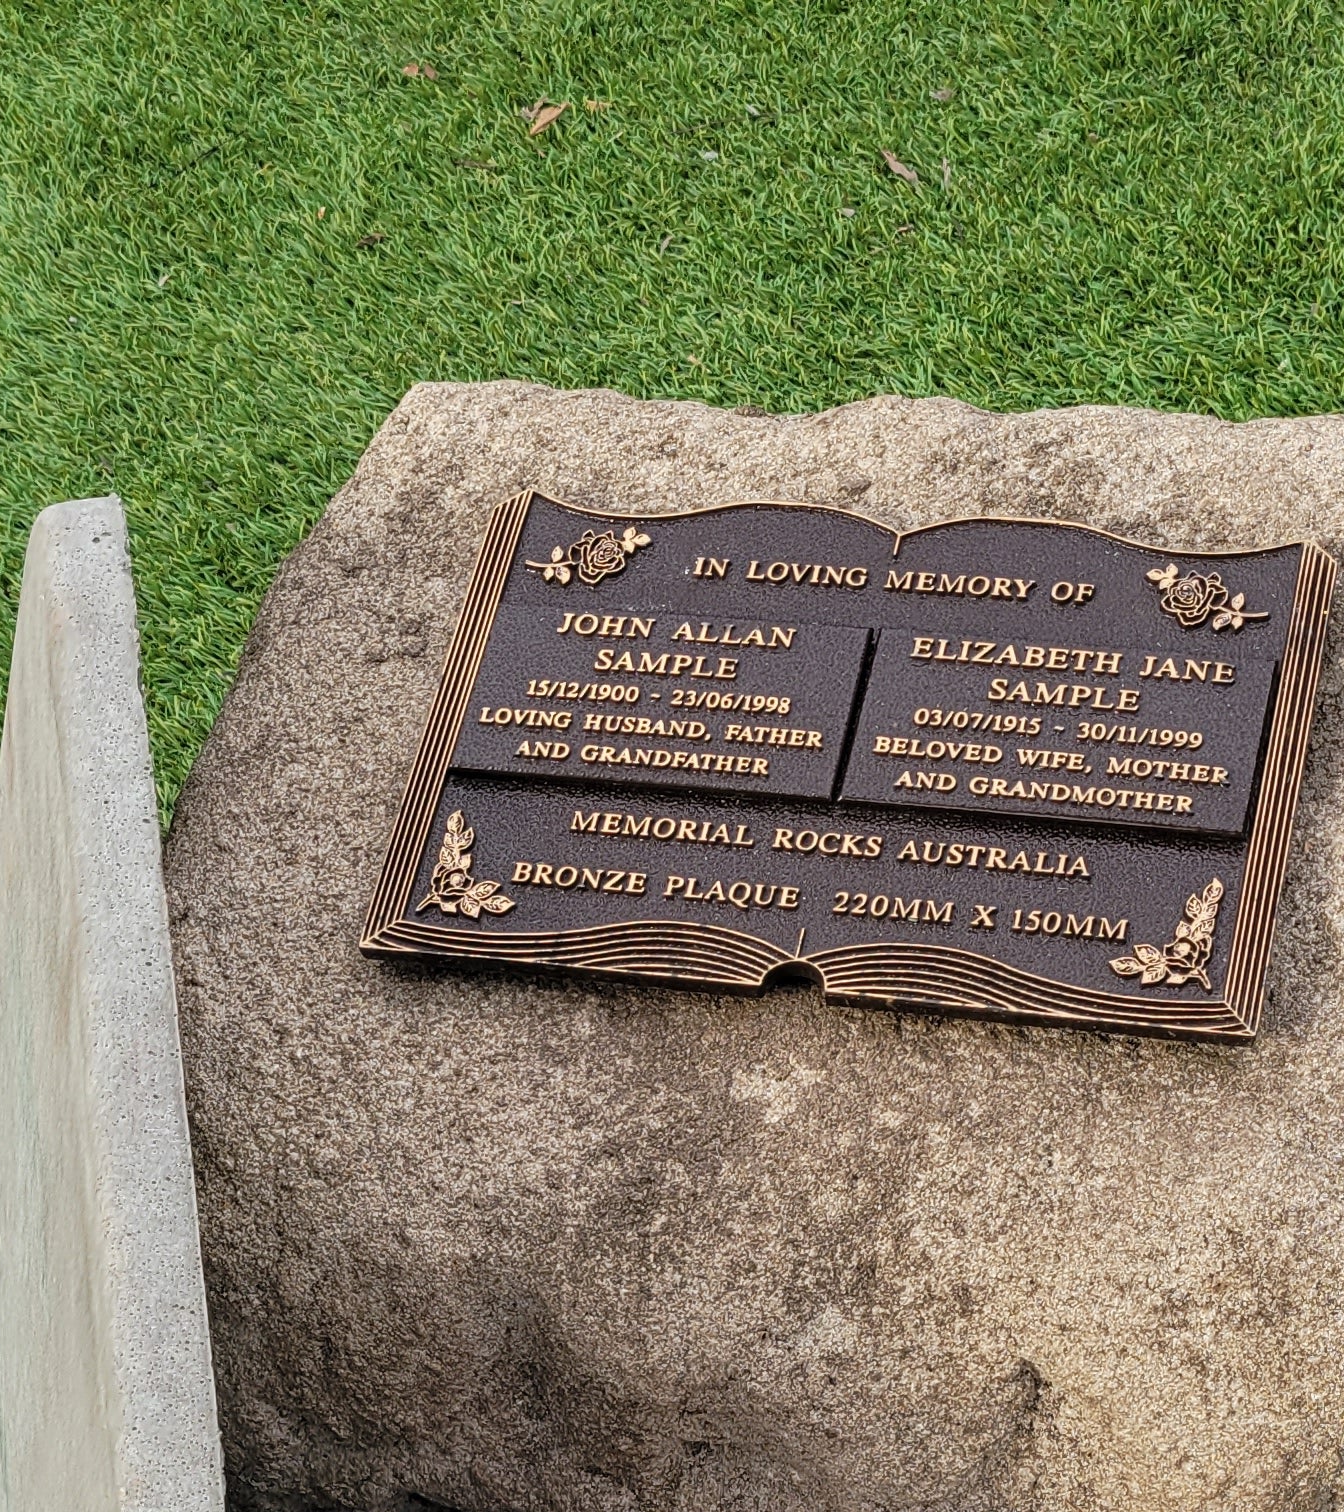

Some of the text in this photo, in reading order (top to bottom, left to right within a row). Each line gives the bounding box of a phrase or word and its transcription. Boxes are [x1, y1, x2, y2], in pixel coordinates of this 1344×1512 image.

[693, 556, 1095, 603] IN LOVING MEMORY OF
[557, 612, 797, 649] JOHN ALLAN
[595, 649, 738, 679] SAMPLE
[910, 637, 1236, 684] ELIZABETH JANE
[527, 679, 639, 703] 15/12/1900
[671, 688, 791, 715] 23/06/1998
[987, 678, 1140, 712] SAMPLE
[479, 706, 823, 749] LOVING HUSBAND, FATHER
[913, 708, 1042, 735] 03/07/1915
[1076, 722, 1203, 749] 30/11/1999
[515, 741, 770, 776] AND GRANDFATHER
[873, 736, 1229, 785] BELOVED WIFE, MOTHER
[894, 770, 1193, 814] AND GRANDMOTHER
[570, 810, 1092, 877] MEMORIAL ROCKS AUSTRALIA
[511, 862, 1130, 942] BRONZE PLAQUE 220MM X 150MM
